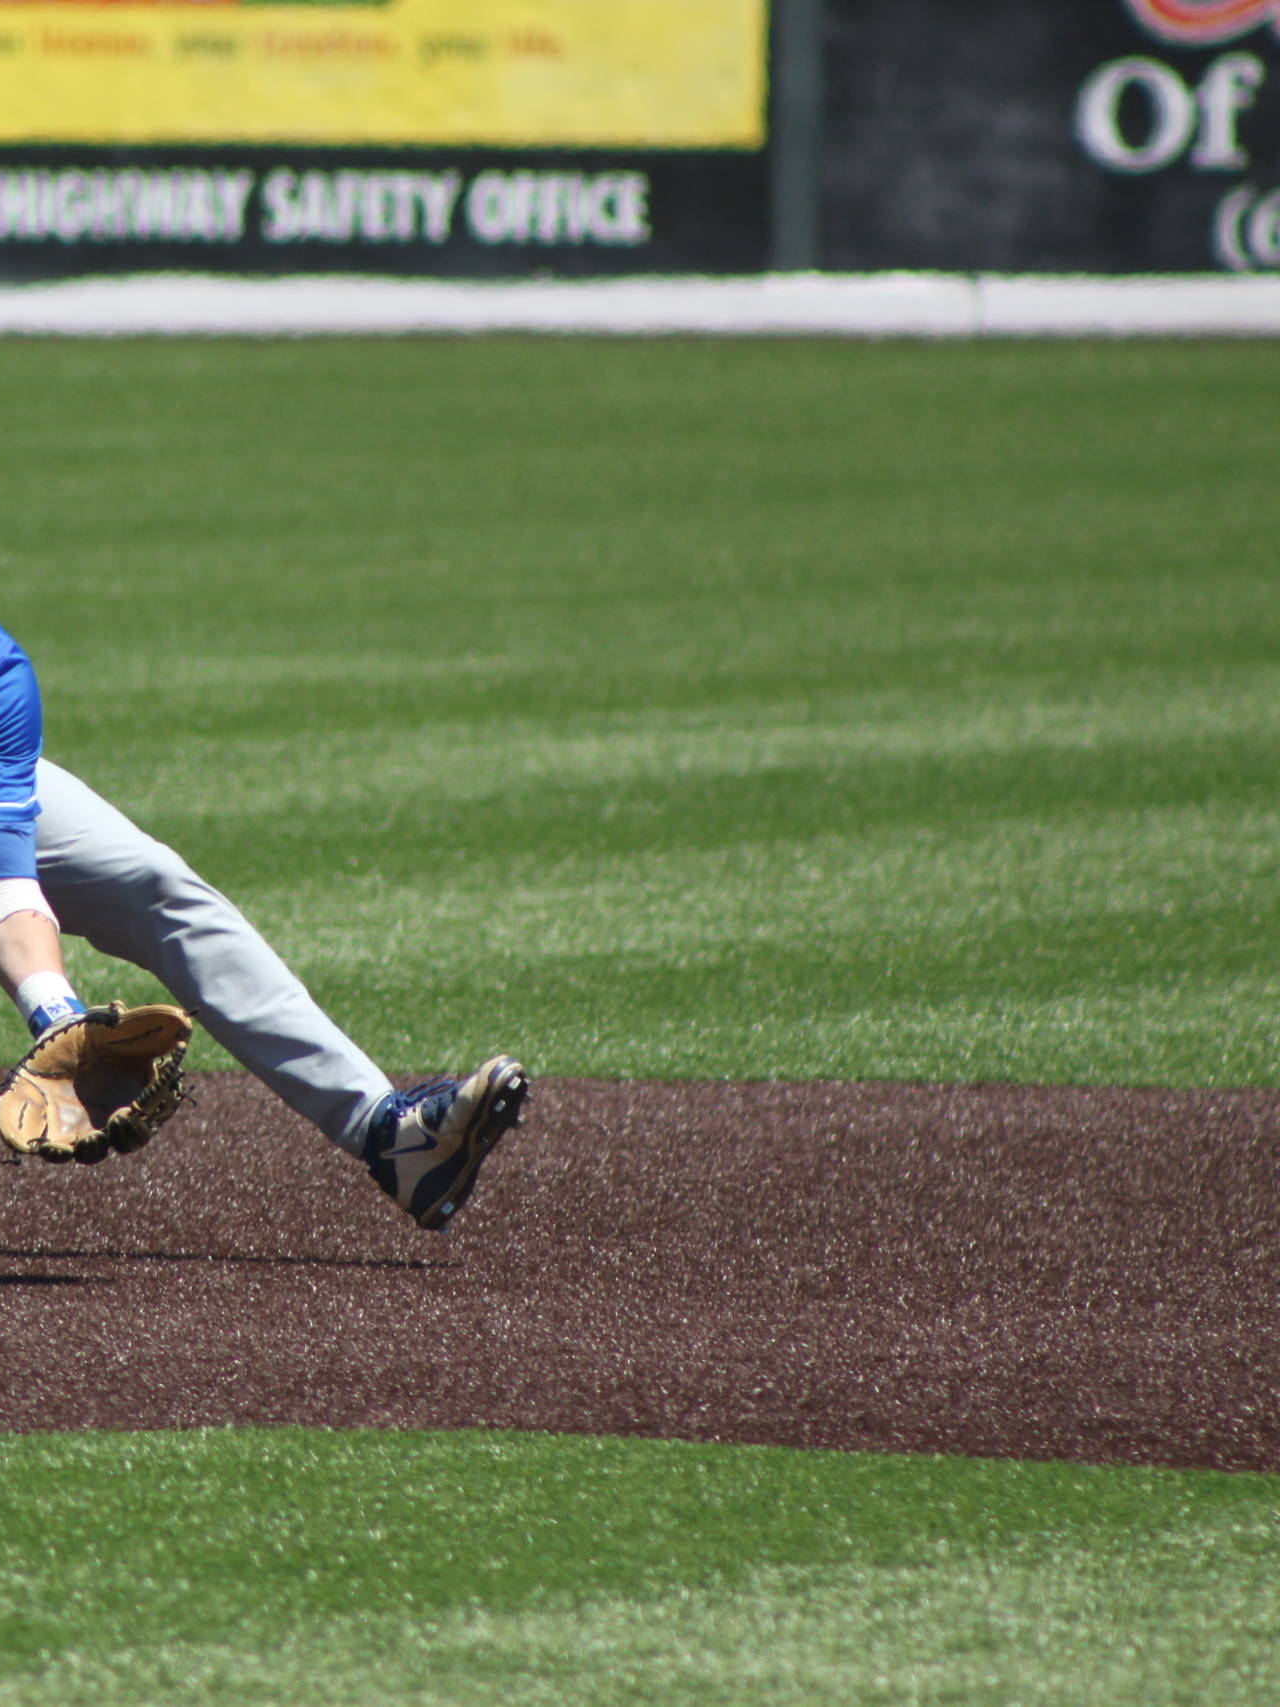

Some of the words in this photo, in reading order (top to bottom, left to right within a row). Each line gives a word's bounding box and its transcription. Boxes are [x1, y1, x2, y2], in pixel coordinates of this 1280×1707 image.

[1076, 54, 1263, 170] Of
[262, 169, 459, 242] SAFETY
[466, 170, 648, 244] OFFICE
